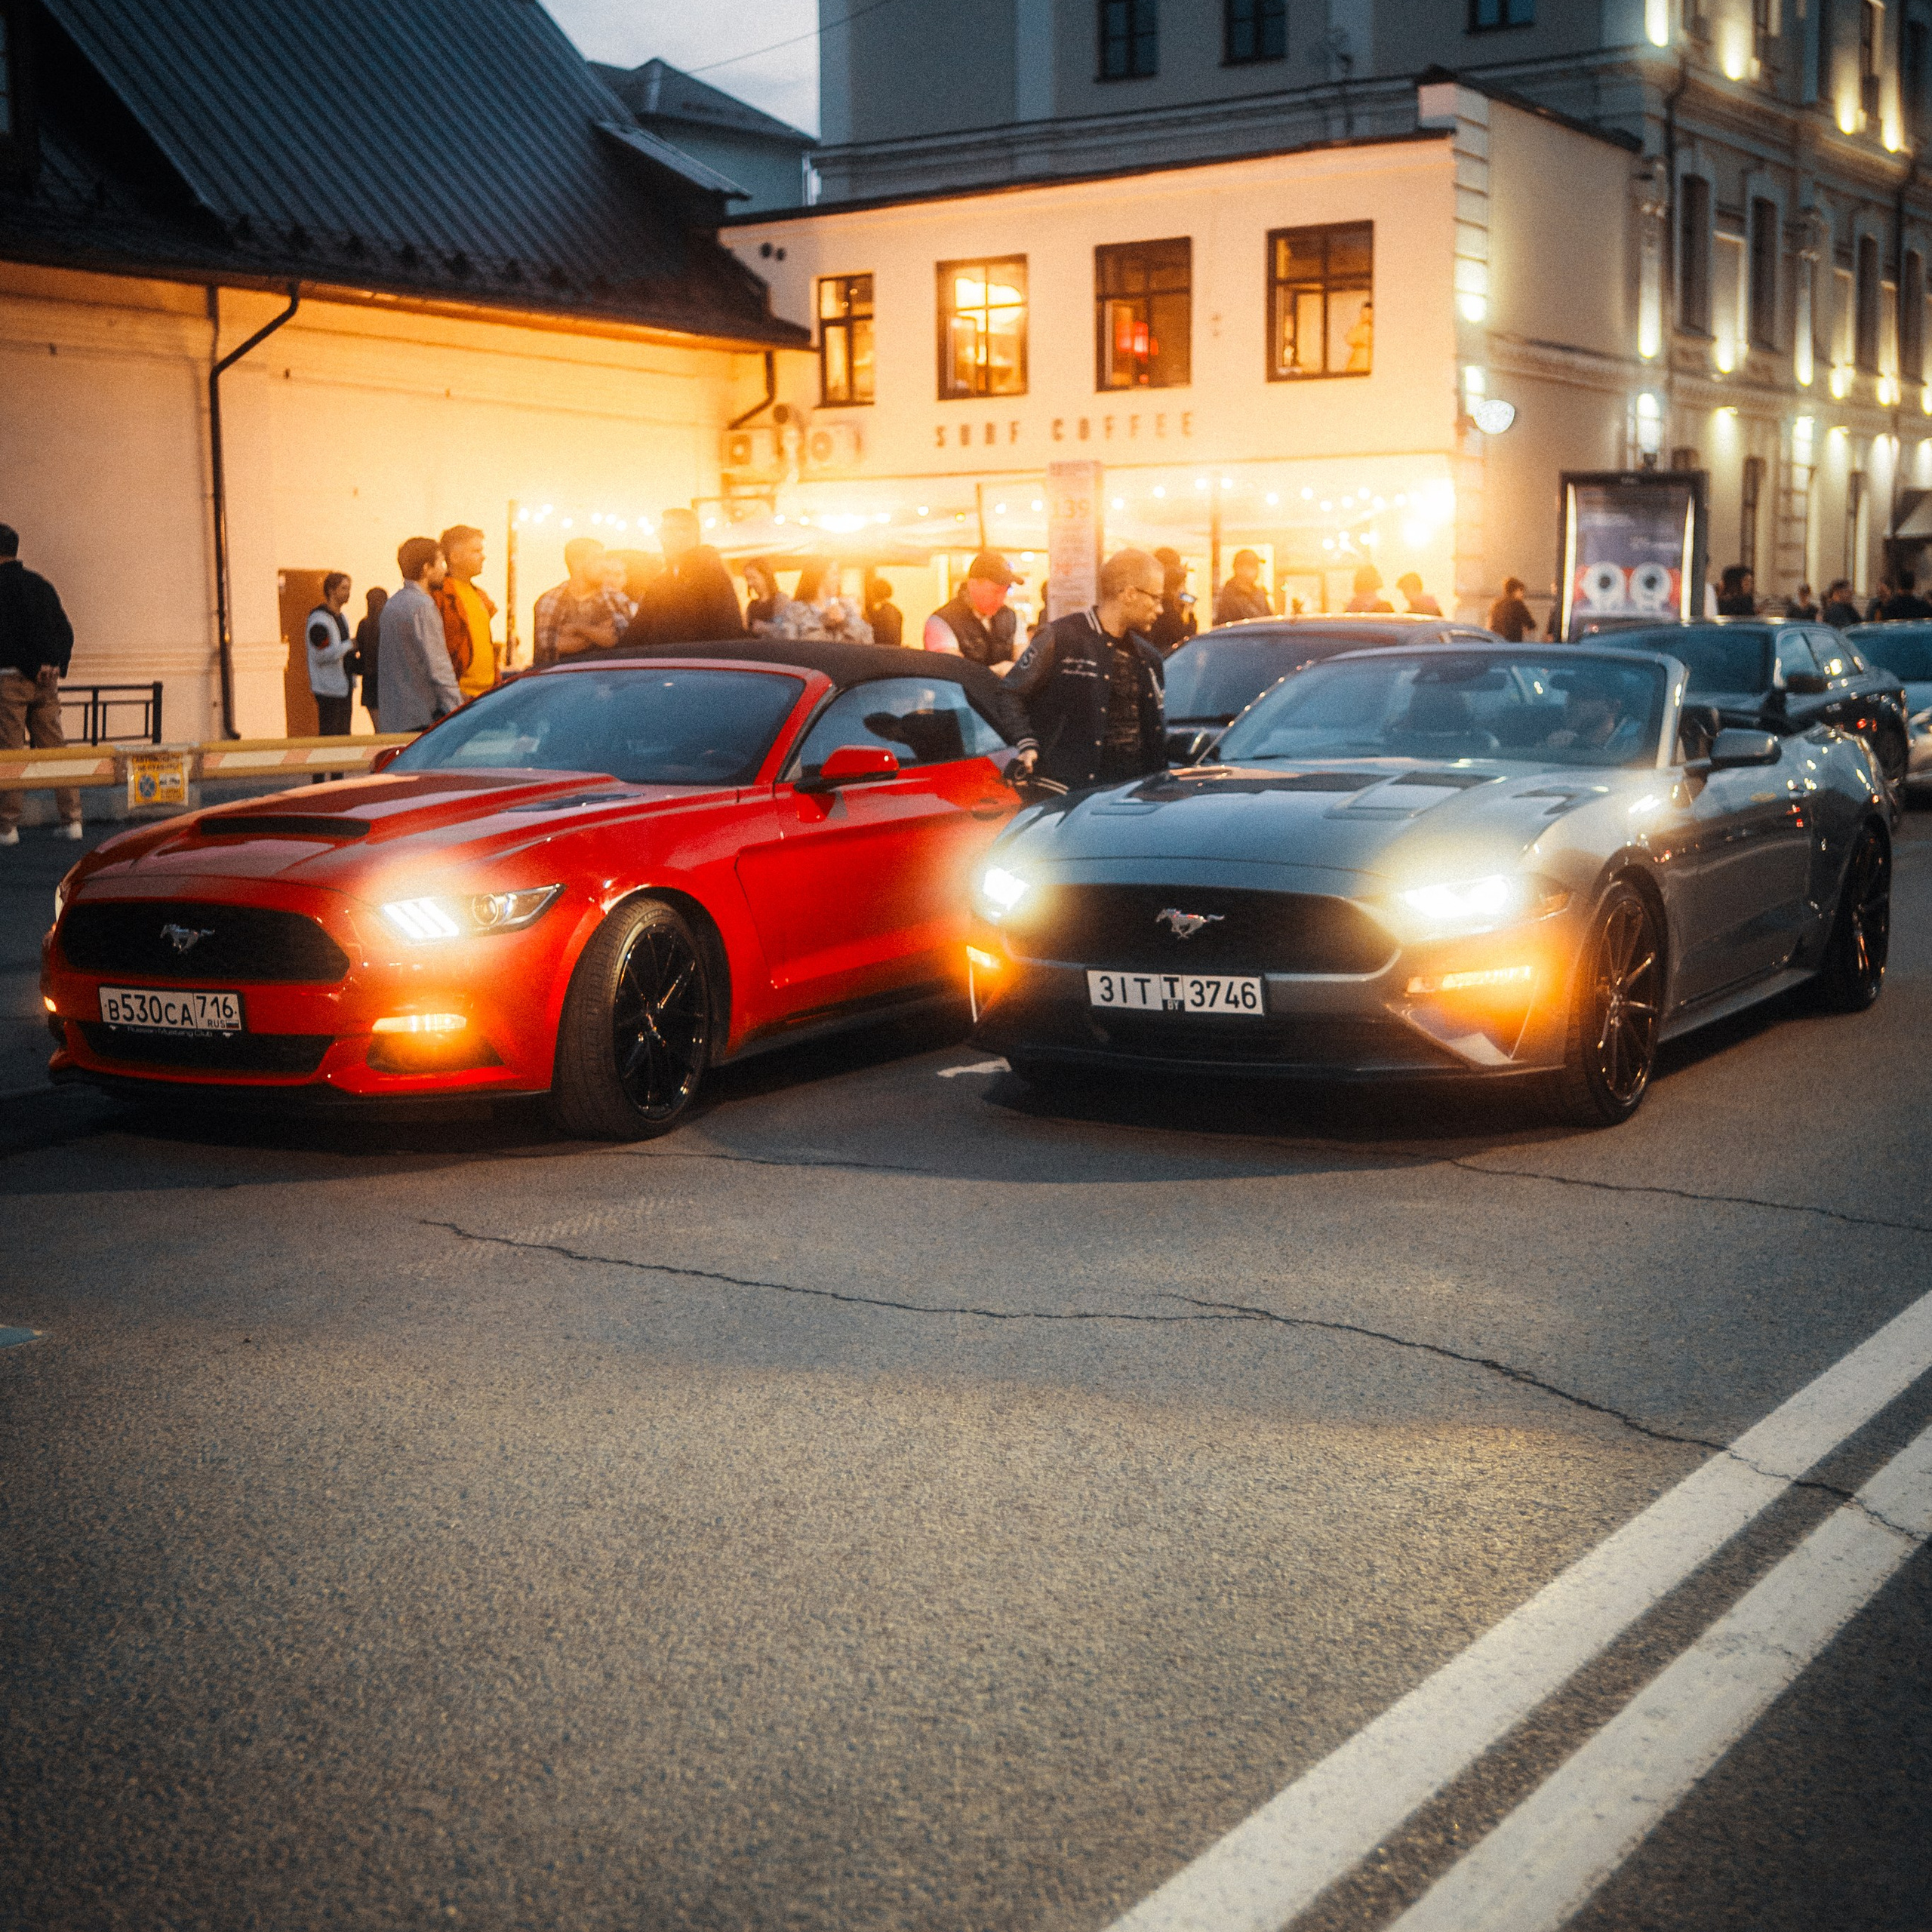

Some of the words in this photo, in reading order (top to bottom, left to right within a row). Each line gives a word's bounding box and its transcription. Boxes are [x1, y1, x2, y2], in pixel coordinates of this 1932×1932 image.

[934, 420, 1020, 448] SURF
[1051, 411, 1194, 442] COFFEE
[1189, 980, 1257, 1009] 3746
[196, 995, 233, 1019] 716
[158, 1028, 193, 1038] Mustang
[195, 1029, 213, 1038] Club
[208, 1019, 225, 1029] RUS
